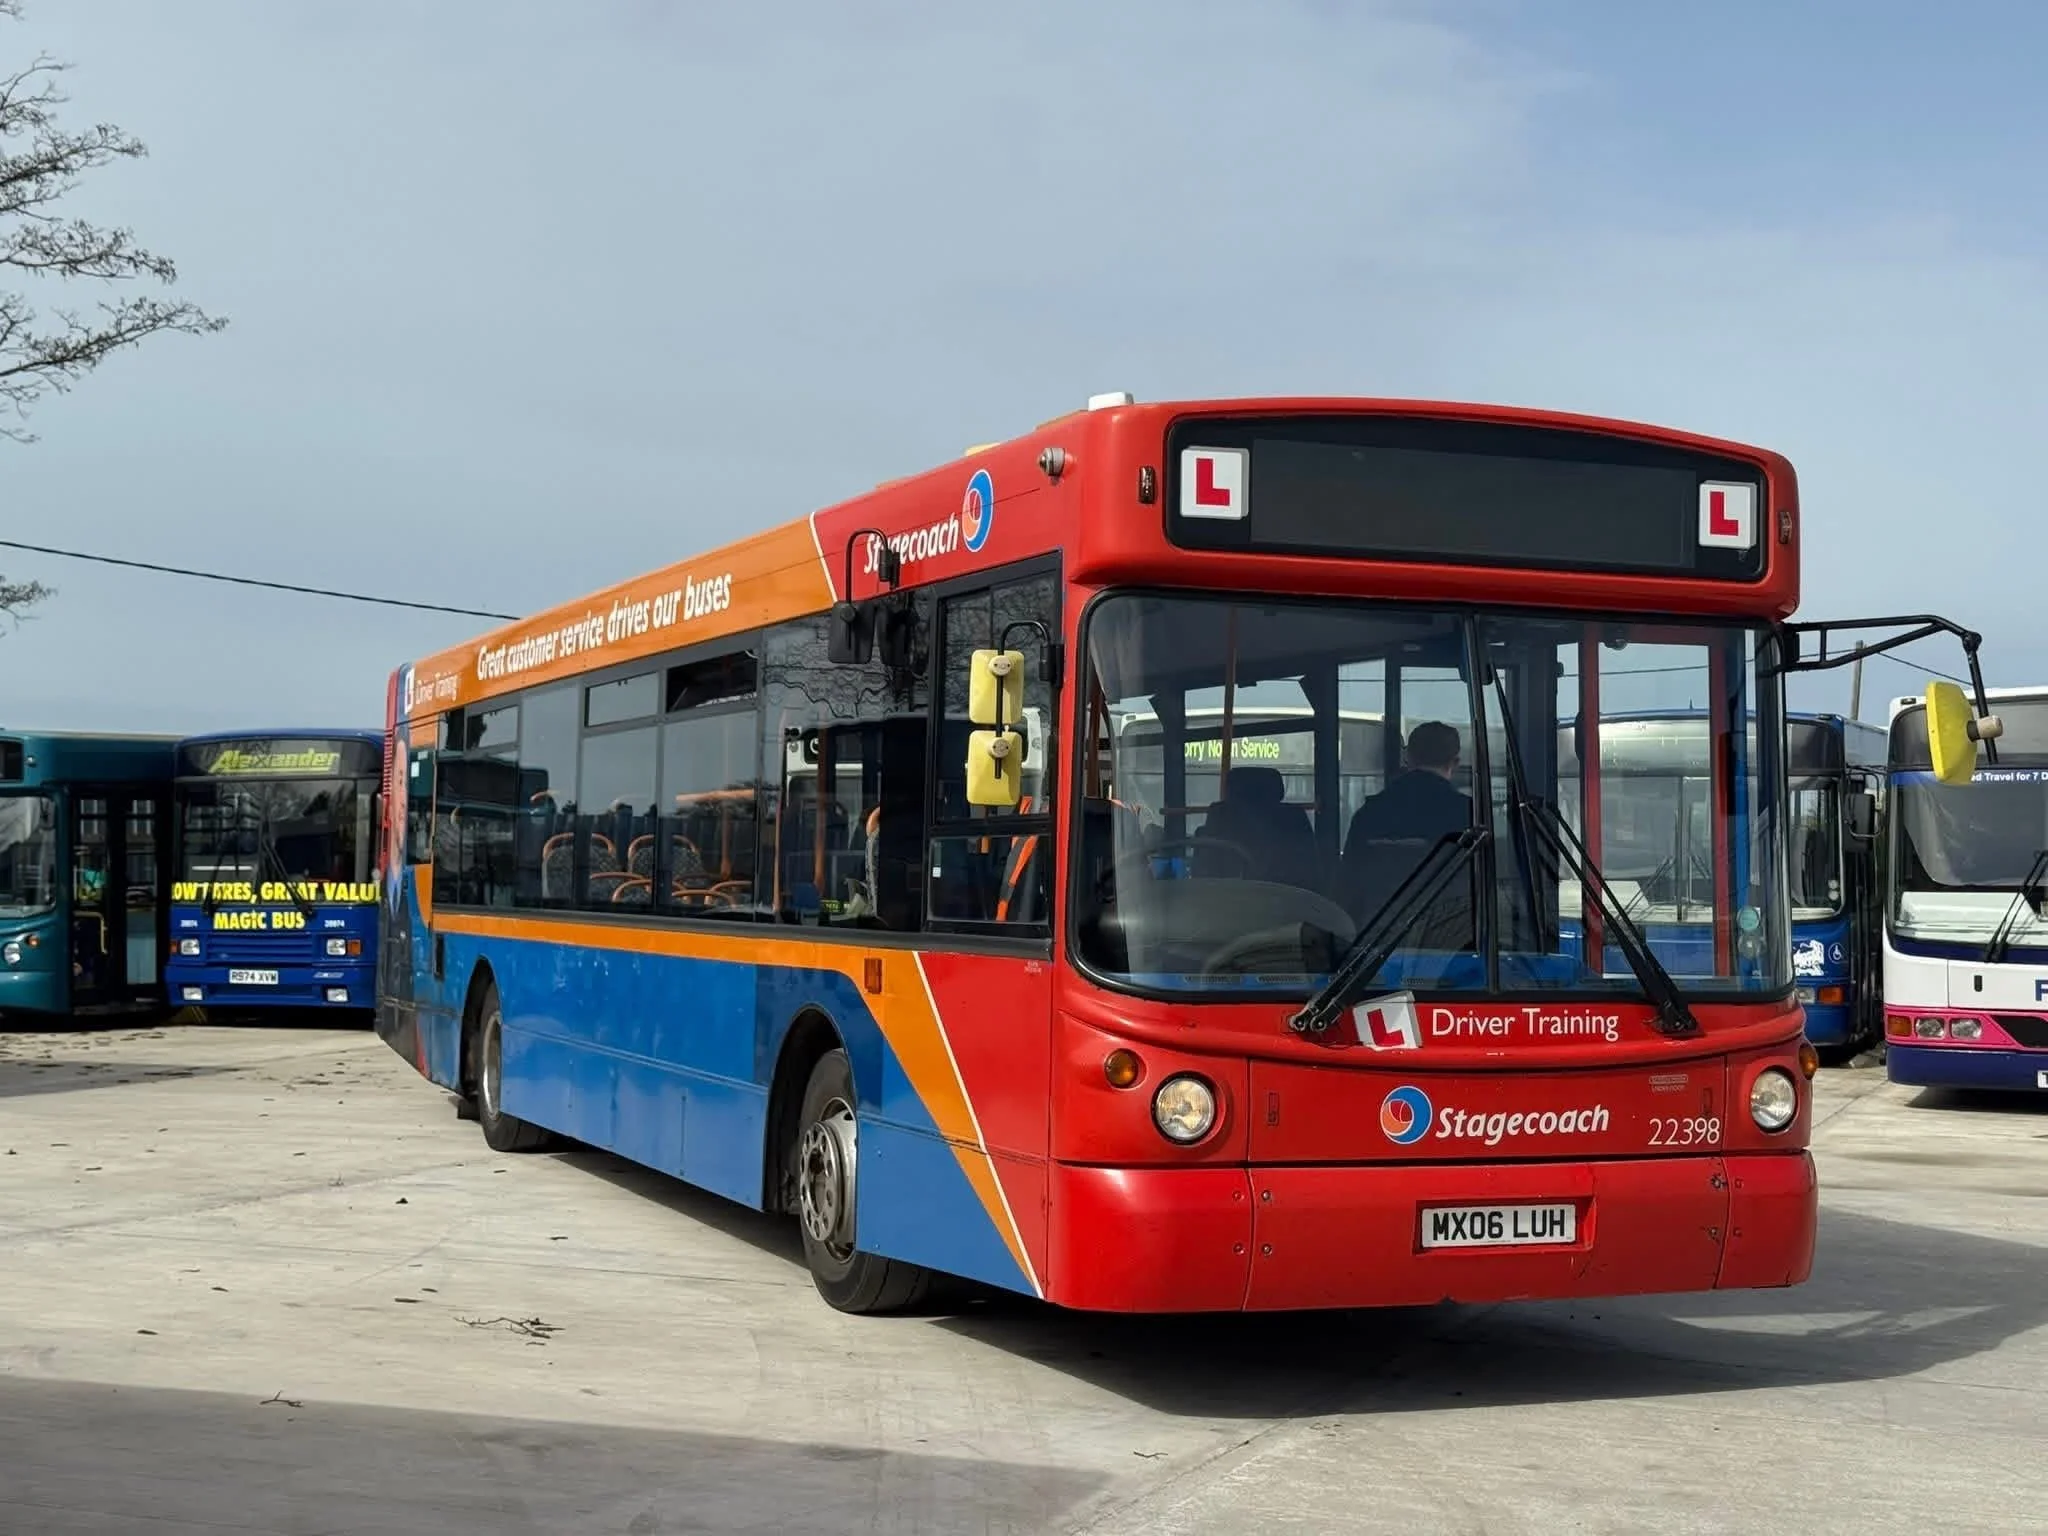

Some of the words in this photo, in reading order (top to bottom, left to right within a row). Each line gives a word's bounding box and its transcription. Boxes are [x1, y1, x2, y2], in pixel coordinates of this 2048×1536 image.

[1196, 458, 1230, 505] L
[1710, 491, 1739, 535] L
[864, 512, 959, 574] Stecoach
[477, 645, 506, 681] Great
[508, 631, 559, 671] customer
[560, 610, 605, 657] service
[607, 597, 650, 643] drives
[653, 589, 681, 629] our
[684, 573, 732, 621] buses
[208, 748, 340, 773] Alexander
[1184, 742, 1205, 761] orry
[1208, 740, 1223, 757] No
[1241, 737, 1280, 759] Service
[1984, 772, 2014, 781] Travel
[2016, 772, 2031, 781] for
[2032, 772, 2039, 781] 7
[2041, 772, 2048, 781] D
[272, 911, 306, 929] BUS
[1367, 1008, 1405, 1046] L
[1432, 1008, 1516, 1036] Driver
[1522, 1007, 1619, 1042] Training
[1436, 1104, 1610, 1146] Stagecoach
[1648, 1117, 1720, 1145] 22398
[1433, 1210, 1504, 1241] MX06
[1513, 1209, 1566, 1239] LUH
